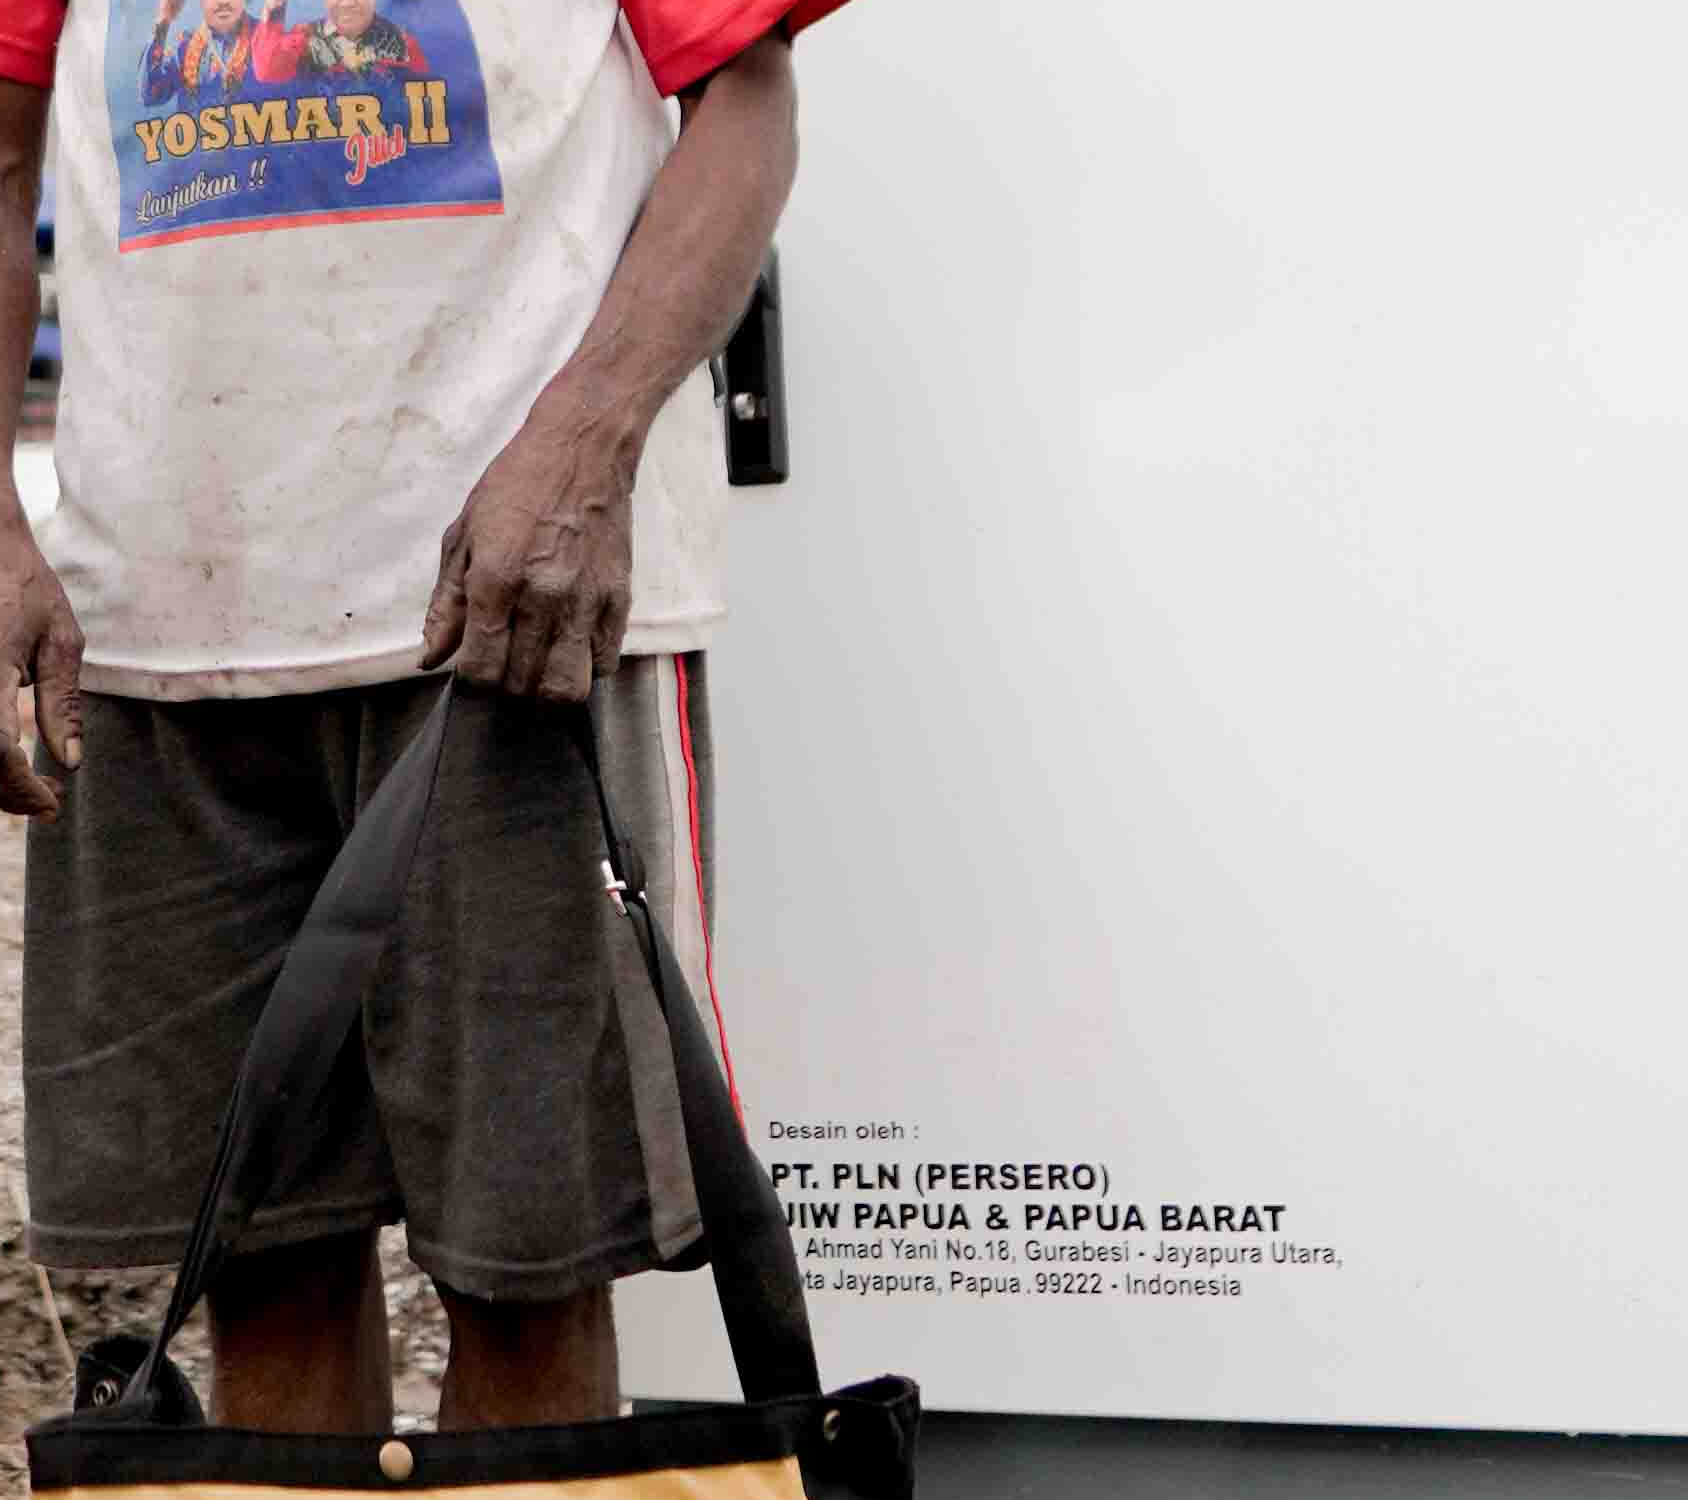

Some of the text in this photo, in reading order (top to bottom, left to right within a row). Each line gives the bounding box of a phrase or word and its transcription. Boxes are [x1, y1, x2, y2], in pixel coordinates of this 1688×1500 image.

[135, 80, 451, 163] YOSMAR II
[769, 1121, 847, 1140] Desain
[855, 1120, 905, 1140] oleh
[771, 1163, 1111, 1197] PT. PLN (PERSERO)
[854, 1203, 970, 1230] PAPUA
[985, 1205, 1009, 1230] &
[1025, 1203, 1146, 1232] PAPUA
[1161, 1204, 1286, 1233] BARAT
[805, 1238, 882, 1259] Ahmad
[891, 1238, 938, 1259] Yani
[946, 1240, 1017, 1264] No.18,
[1025, 1240, 1130, 1262] Gurabesi
[1153, 1241, 1263, 1268] Jayapura
[1273, 1243, 1344, 1269] Utara,
[832, 1270, 943, 1295] Jayapura,
[1127, 1274, 1242, 1296] Indonesia
